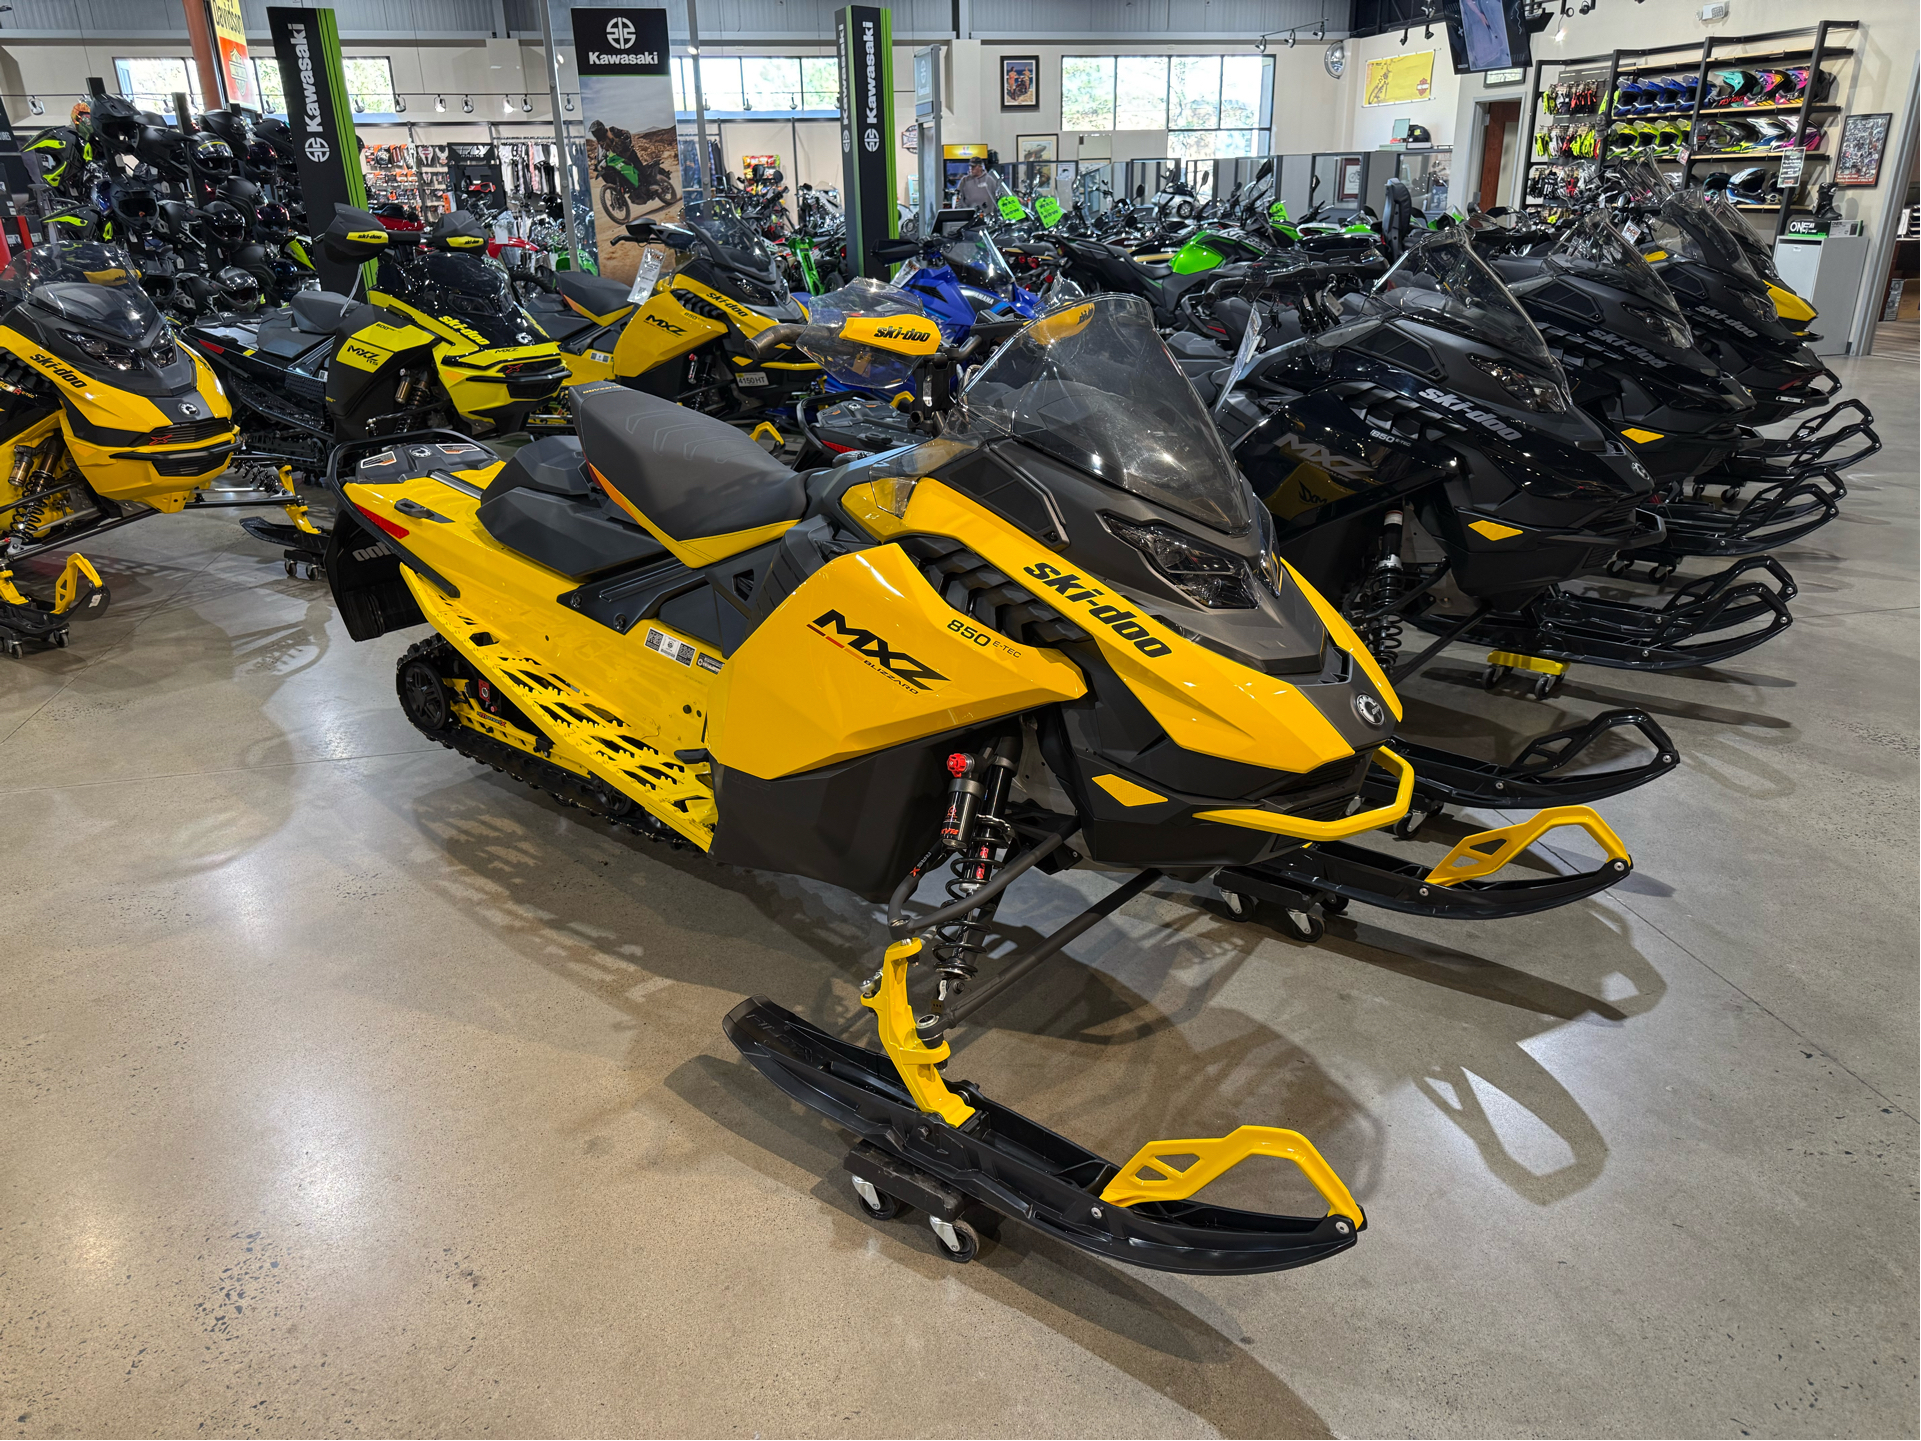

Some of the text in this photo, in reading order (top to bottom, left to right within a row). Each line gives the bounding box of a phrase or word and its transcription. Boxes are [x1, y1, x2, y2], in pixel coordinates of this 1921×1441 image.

[588, 51, 659, 65] Kawasaki
[838, 23, 850, 125] Kawasaki
[862, 21, 878, 124] Kawasaki
[288, 22, 323, 133] Kawasaki
[1043, 210, 1059, 219] NOW
[706, 291, 749, 318] ski-doo
[1697, 304, 1759, 339] ski-doo
[438, 315, 491, 346] ski-doo
[645, 314, 688, 336] MXZ
[873, 325, 931, 343] ski-doo
[346, 344, 381, 362] MXZ
[1586, 328, 1668, 369] ski-doo
[29, 353, 88, 389] ski-doo
[1417, 387, 1524, 442] ski-doo
[1370, 429, 1395, 443] 850
[1273, 432, 1376, 481] MXZ
[1022, 561, 1173, 660] ski-doo
[811, 608, 952, 692] MXZ
[946, 618, 1022, 659] 850 E-TEC
[863, 659, 919, 695] BLIZZARD
